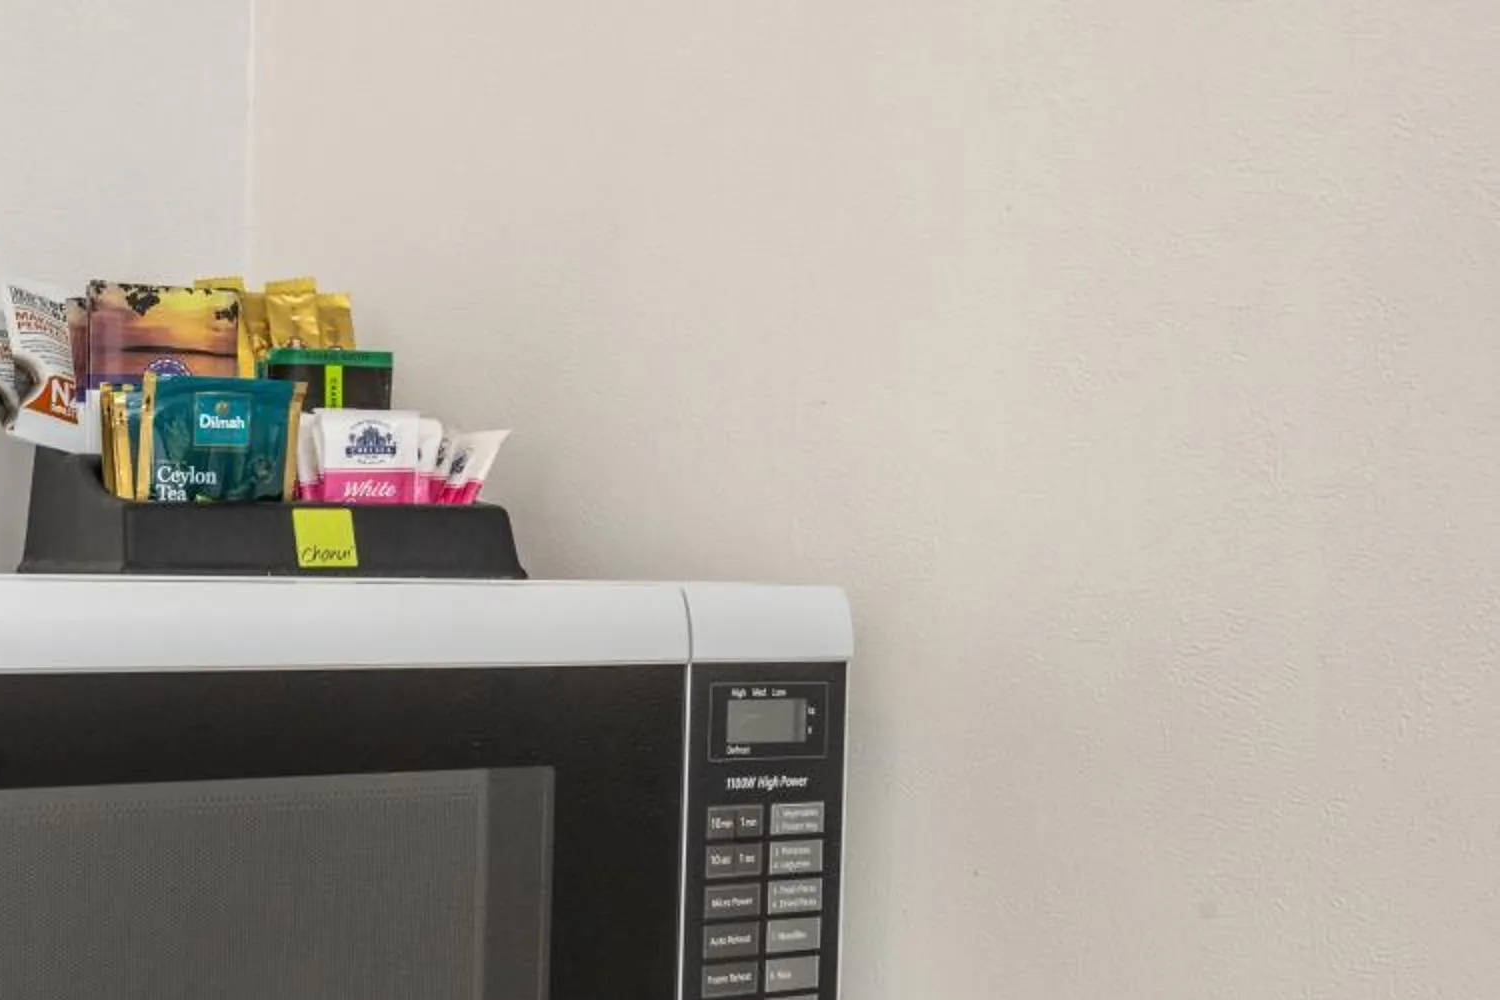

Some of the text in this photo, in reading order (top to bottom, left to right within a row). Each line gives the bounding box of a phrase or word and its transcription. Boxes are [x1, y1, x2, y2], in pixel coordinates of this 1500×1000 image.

[199, 414, 245, 430] Dilmah
[157, 465, 218, 488] Ceylon
[156, 484, 187, 501] Tea
[343, 479, 397, 498] White
[757, 775, 779, 791] High
[779, 774, 810, 788] Power
